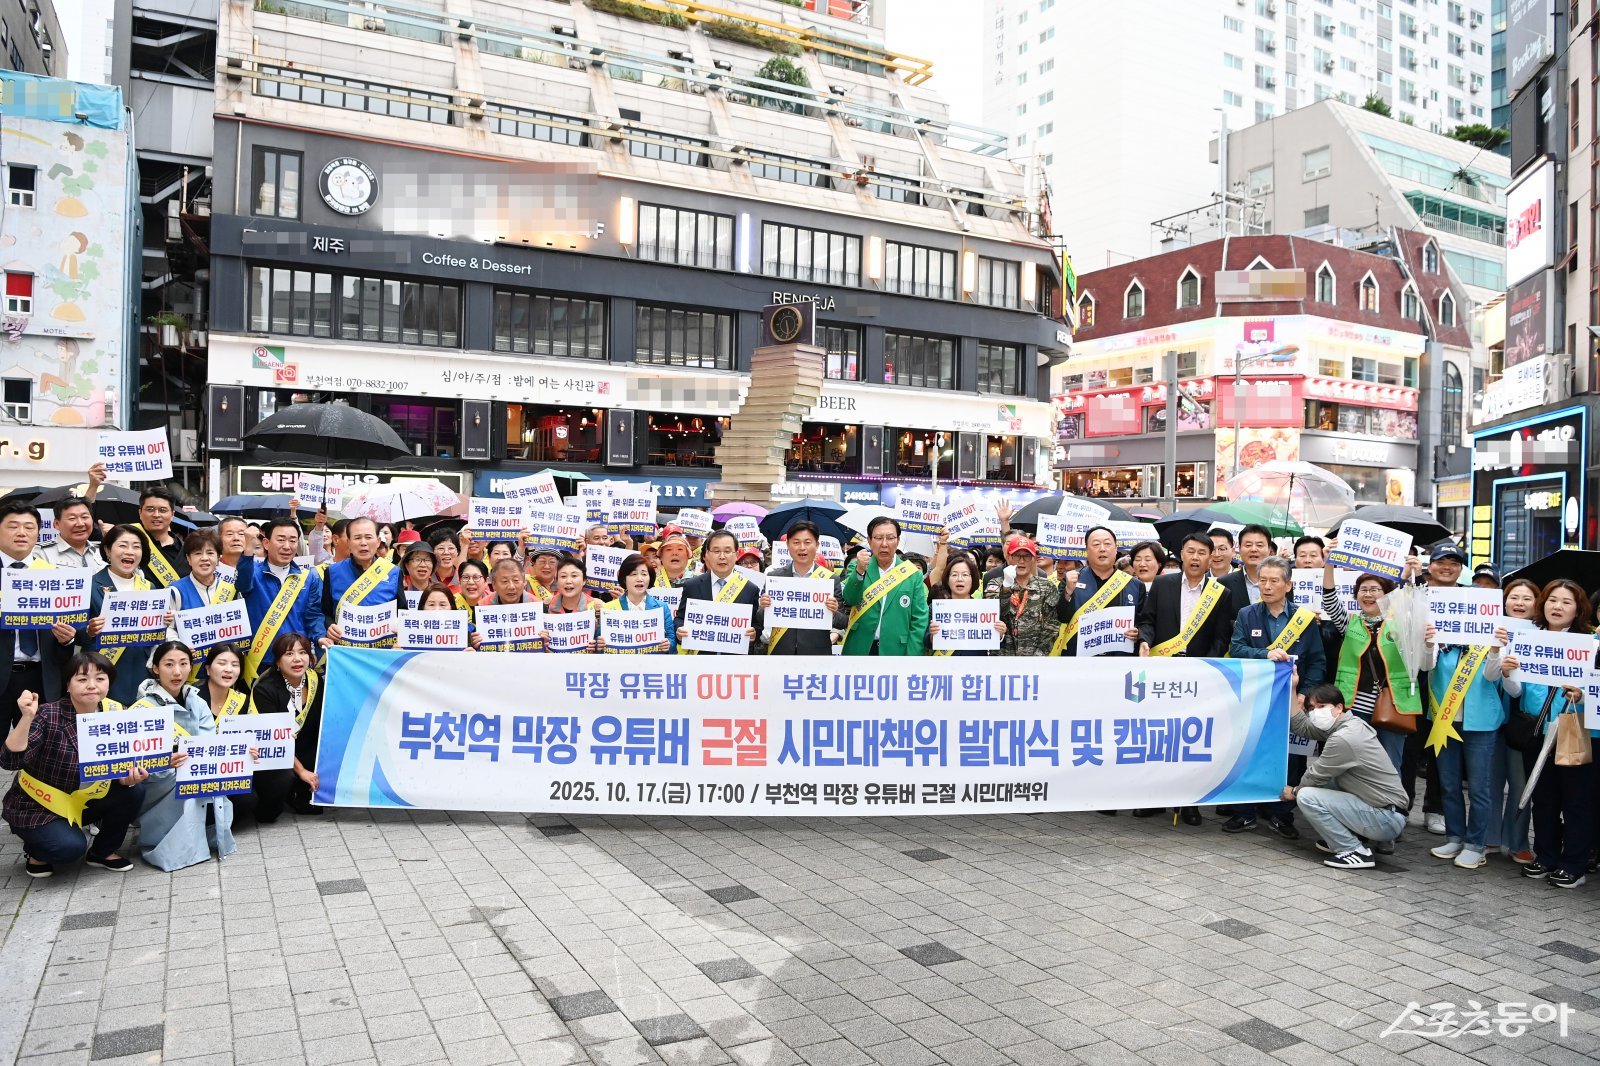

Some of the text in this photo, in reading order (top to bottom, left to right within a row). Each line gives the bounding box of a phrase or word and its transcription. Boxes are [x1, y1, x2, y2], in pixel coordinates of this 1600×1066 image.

[312, 236, 345, 253] 제주
[422, 251, 532, 275] Coffee & Dessert
[347, 378, 408, 391] 070-8832-1007
[441, 370, 501, 386] 심/야/주/점
[538, 378, 560, 390] 여는
[564, 379, 595, 392] 사진관
[819, 395, 856, 411] BEER
[99, 442, 165, 456] 막장 유튜버 OUT
[105, 459, 163, 473] 부천을 떠나라
[328, 487, 341, 495] OUT
[505, 490, 518, 500] 막장
[519, 486, 539, 496] 유튜버
[539, 483, 554, 493] OUT
[652, 485, 699, 497] KERY
[796, 483, 835, 496] TABLE
[844, 491, 879, 501] 24HOUR
[474, 505, 523, 515] 폭력·위협·도발
[630, 511, 649, 520] OUT!
[902, 509, 940, 522] 유튜버 OUT!
[962, 504, 977, 515] OUT
[477, 518, 520, 527] 유튜버 OUT!
[530, 510, 581, 524] 폭력·위협·도발
[533, 523, 577, 537] 유튜버 OUT!
[1343, 526, 1403, 548] 폭력·위협·도발
[1046, 534, 1067, 545] 유튜버
[1343, 540, 1397, 562] 유튜버 OUT!
[594, 566, 616, 577] 유튜버
[1329, 552, 1401, 578] 안전한 부천역 지켜주세요
[11, 578, 85, 591] 폭력·위협·도발
[17, 595, 81, 609] 유튜버 OUT!
[276, 589, 294, 611] 유튜버
[767, 589, 831, 603] 막장 유튜버 OUT
[109, 599, 166, 612] 폭력·위협·도발
[1448, 602, 1500, 617] 유튜버 OUT
[4, 614, 54, 626] 안전한 부천역
[183, 609, 242, 630] 폭력·위협·도발
[342, 609, 392, 624] 폭력·위협·도발
[482, 611, 537, 624] 폭력·위협·도발
[773, 606, 825, 620] 부천을 떠나라
[935, 612, 998, 624] 막장 유튜버 OUT
[111, 614, 163, 628] 유튜버 OUT!
[404, 619, 461, 630] 폭력·위협·도발
[605, 617, 658, 629] 폭력·위협·도발
[687, 612, 749, 629] 막장 유튜버 OUT
[1079, 618, 1133, 635] 막장 유튜버 OUT
[1434, 620, 1494, 635] 부천을 떠나라
[191, 624, 243, 645] 유튜버 OUT!
[344, 623, 390, 638] 유튜버 OUT!
[487, 626, 536, 639] 유튜버 OUT!
[610, 631, 657, 643] 유튜버 OUT!
[691, 629, 742, 644] 부천을 떠나라
[941, 629, 992, 640] 부천을 떠나라
[100, 631, 166, 645] 안전한 부천역 지켜주세요
[252, 626, 272, 654] STOP
[408, 634, 459, 645] 유튜버 OUT!
[569, 634, 589, 646] OUT!
[1083, 633, 1127, 650] 부천을 떠나라
[1158, 640, 1183, 656] STOP
[1514, 643, 1590, 661] 막장 유튜버 OUT
[1460, 651, 1479, 676] 유튜버
[1519, 662, 1583, 678] 부천을 떠나라
[565, 672, 1040, 701] 막장 유튜버 OUT! 부천시민이 함께 합니다!
[1151, 680, 1198, 700] 부천시
[1440, 692, 1458, 721] STOP
[88, 718, 165, 737] 폭력·위협·도발
[273, 728, 292, 740] OUT
[399, 710, 1214, 767] 부천역 막장 유튜버 근절 시민대책위 발대식 및 캠페인
[95, 737, 163, 757] 유튜버 OUT!
[187, 744, 248, 758] 폭력·위협·도발
[258, 746, 286, 759] 떠나라
[83, 763, 109, 777] 안전한
[190, 761, 244, 776] 유튜버 OUT!
[20, 776, 53, 803] STOP
[179, 778, 251, 795] 안전한 부천역 지켜주세요
[549, 780, 1049, 805] 2025. 10. 17.(금) 17:00 부천역 막장 유튜버 근절 시민대책위
